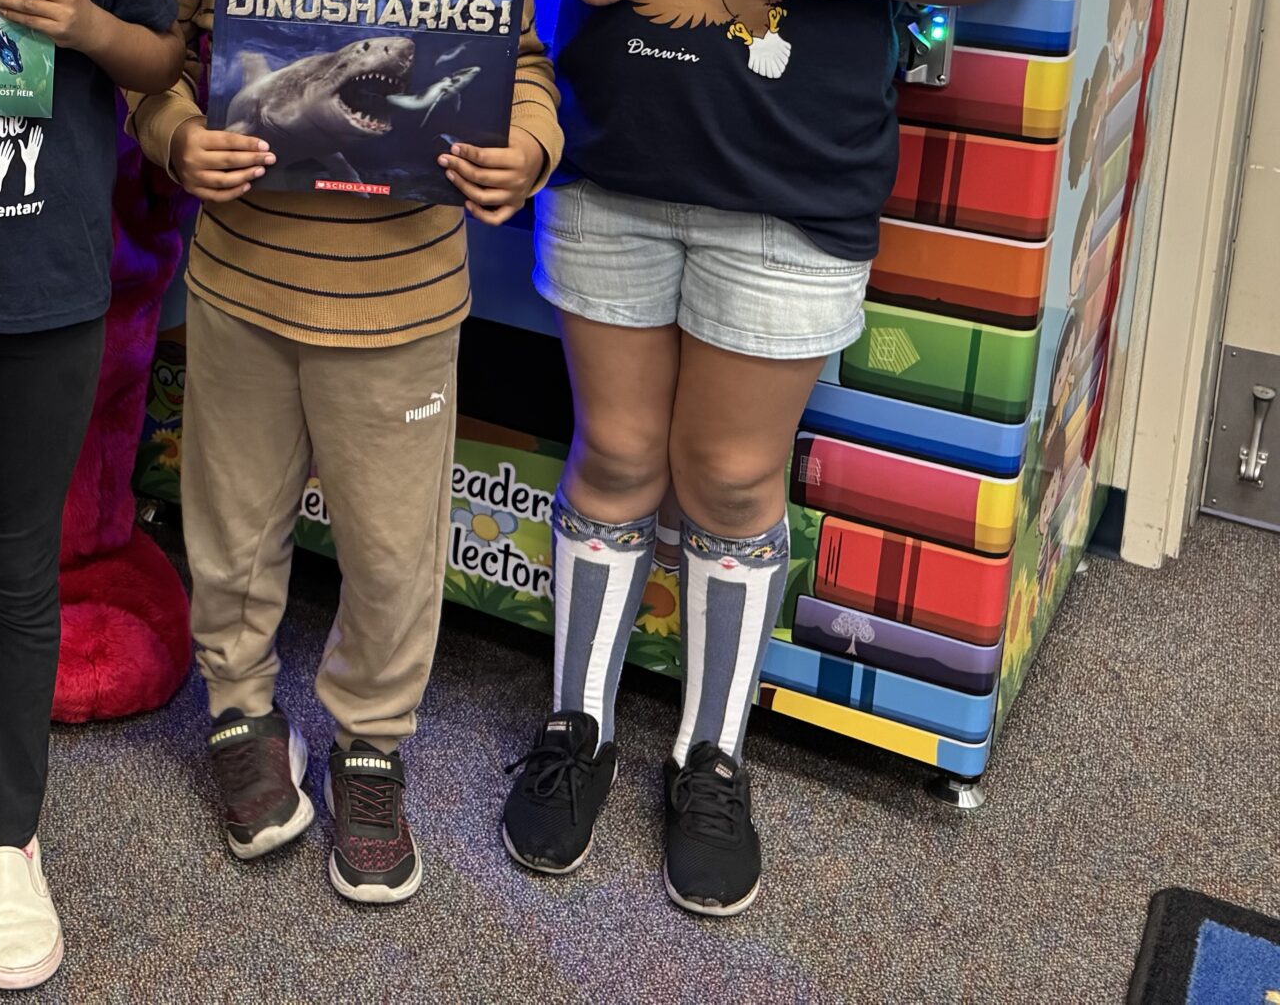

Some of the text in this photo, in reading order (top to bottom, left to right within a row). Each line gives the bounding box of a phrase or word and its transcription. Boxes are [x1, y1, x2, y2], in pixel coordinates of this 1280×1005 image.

[627, 37, 701, 64] Darwin
[16, 90, 34, 98] HEIR
[325, 182, 391, 195] SCHOLASTIC
[452, 467, 552, 518] eader
[452, 526, 552, 592] lector
[345, 758, 392, 770] SKECHERS
